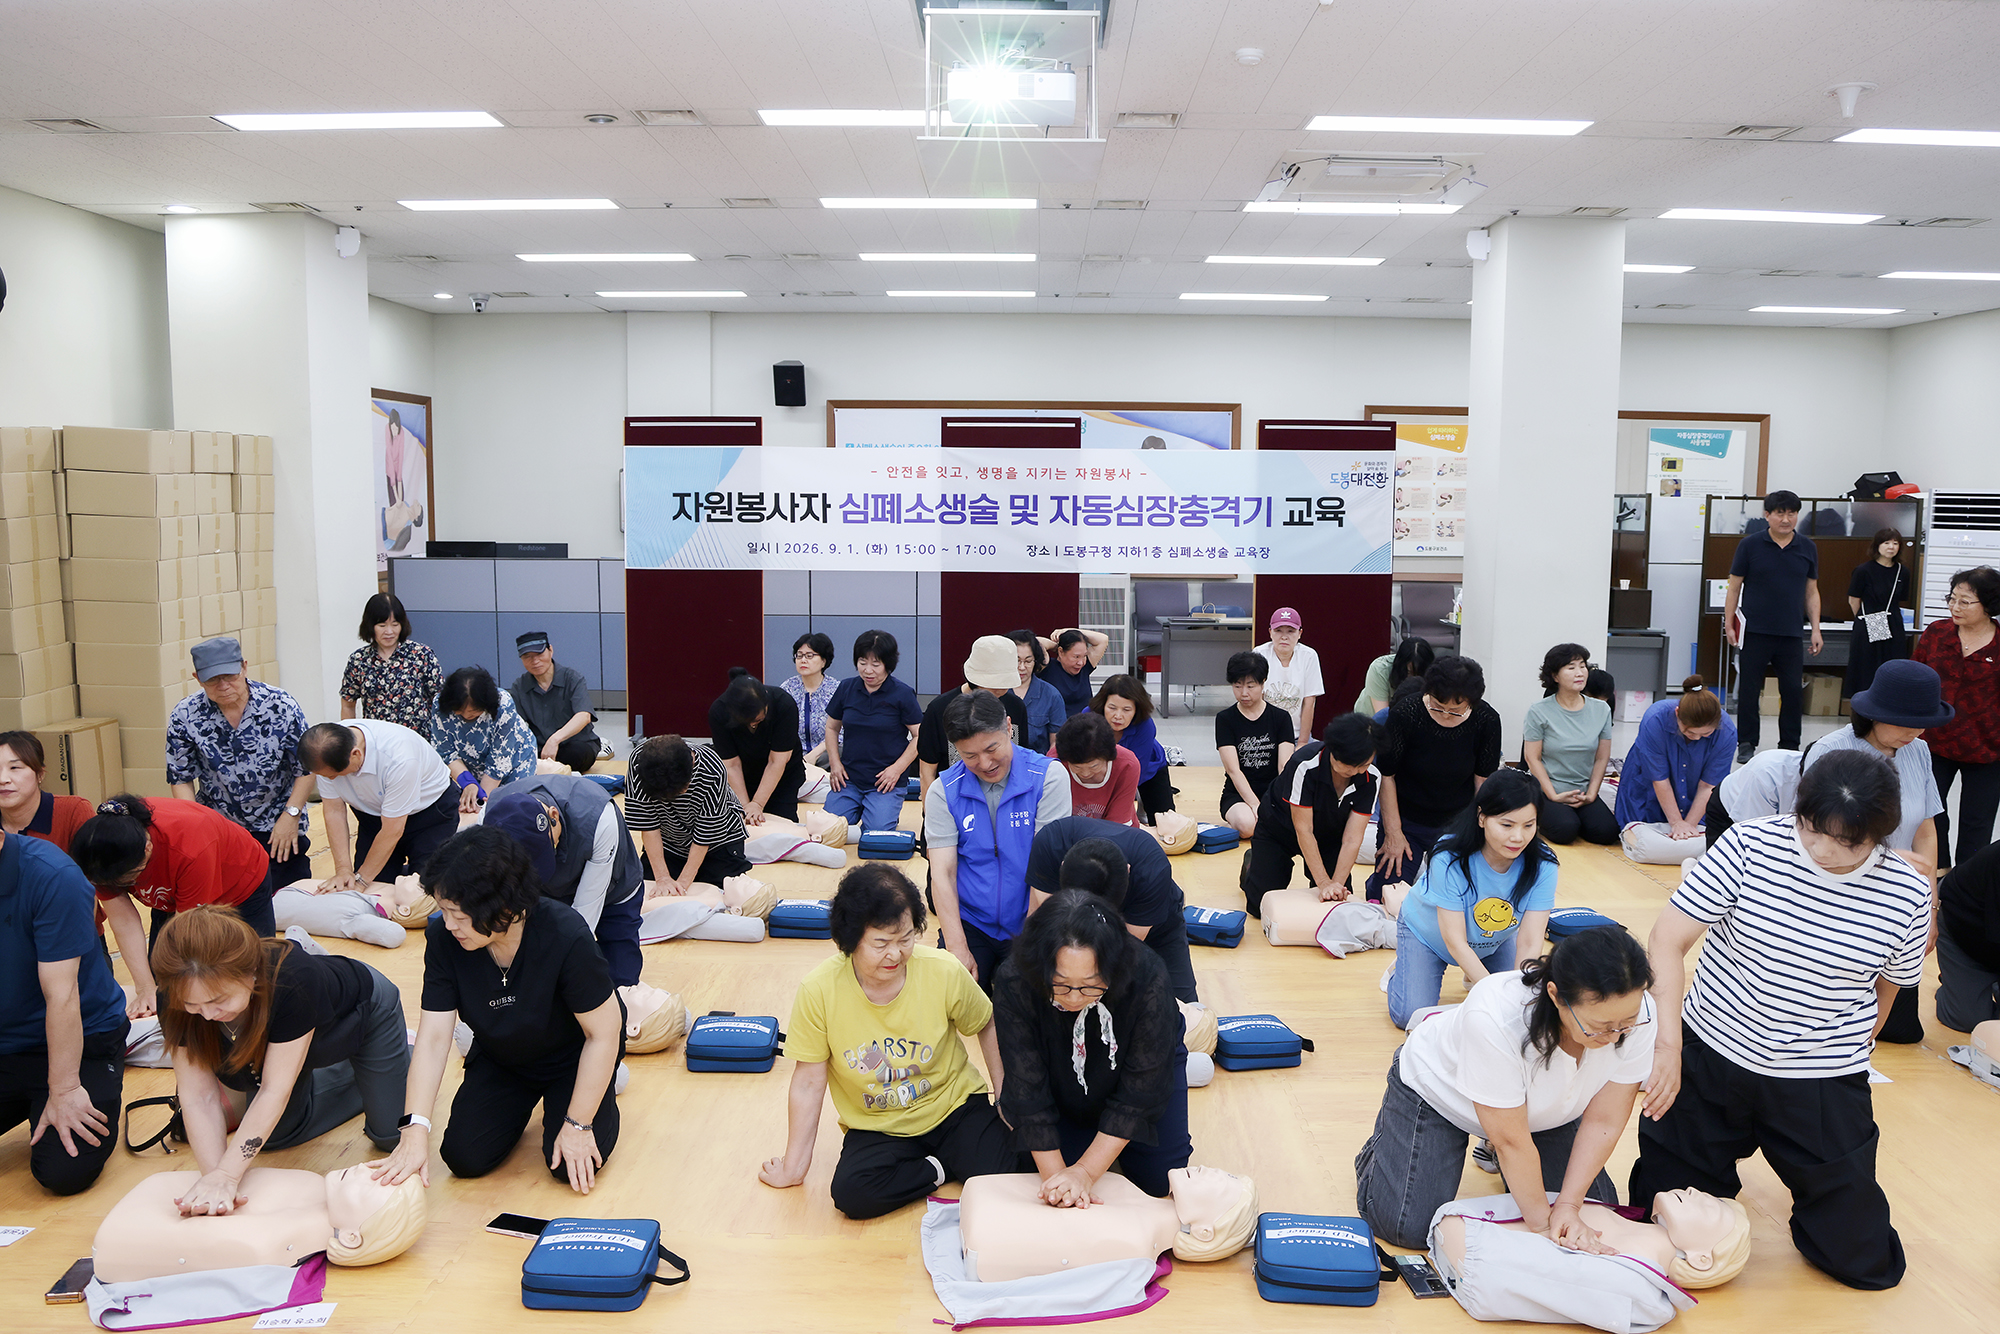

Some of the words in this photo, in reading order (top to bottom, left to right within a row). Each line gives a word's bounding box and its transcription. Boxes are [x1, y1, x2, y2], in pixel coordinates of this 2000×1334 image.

[886, 466, 929, 478] 안전을
[935, 466, 969, 480] 잇고,
[976, 466, 1019, 480] 생명을
[1026, 466, 1068, 480] 지키는
[1075, 466, 1132, 481] 자원봉사
[672, 491, 831, 524] 자원봉사자
[839, 493, 999, 526] 심폐소생술
[1009, 495, 1039, 526] 및
[1049, 494, 1272, 527] 자동심장충격기
[1282, 496, 1346, 527] 교육
[747, 542, 773, 555] 일시
[784, 542, 824, 555] 2026.
[828, 542, 842, 555] 9.
[848, 542, 860, 555] 1.
[865, 542, 889, 556] (화)
[895, 543, 936, 555] 15:00
[956, 543, 997, 556] 17:00
[1026, 544, 1050, 557] 장소
[1063, 544, 1112, 558] 도봉구청
[1117, 545, 1162, 559] 지하1층
[1167, 545, 1230, 559] 심폐소생술
[1234, 546, 1271, 559] 교육장
[489, 995, 516, 1007] GUESS
[562, 1233, 603, 1241] Trainer
[1281, 1239, 1355, 1248] HEARTSTART
